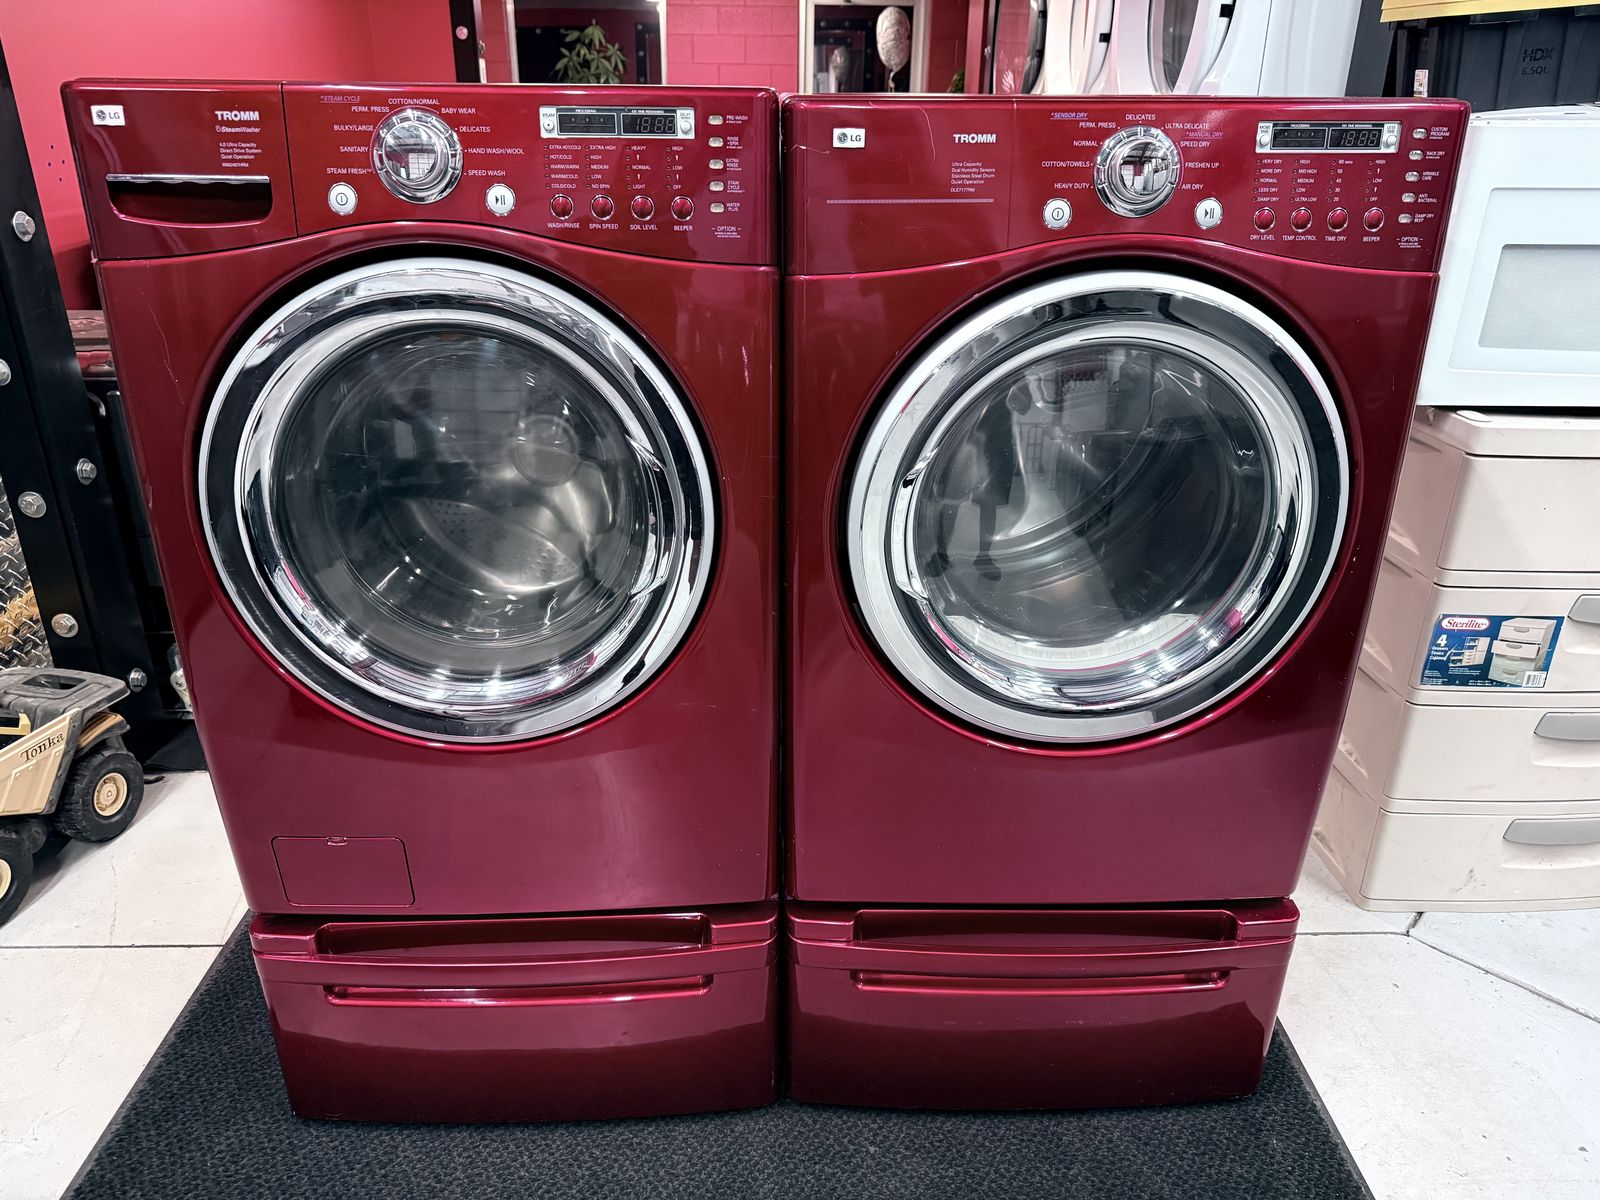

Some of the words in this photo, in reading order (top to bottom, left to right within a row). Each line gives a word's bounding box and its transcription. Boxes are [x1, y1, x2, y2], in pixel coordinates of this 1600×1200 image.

[1522, 47, 1556, 62] HDX
[108, 112, 120, 120] LG
[214, 110, 260, 121] TROMM
[952, 133, 996, 144] TROMM
[1445, 618, 1485, 629] Sterilite
[1436, 634, 1448, 647] 4
[19, 732, 62, 761] Tonka
